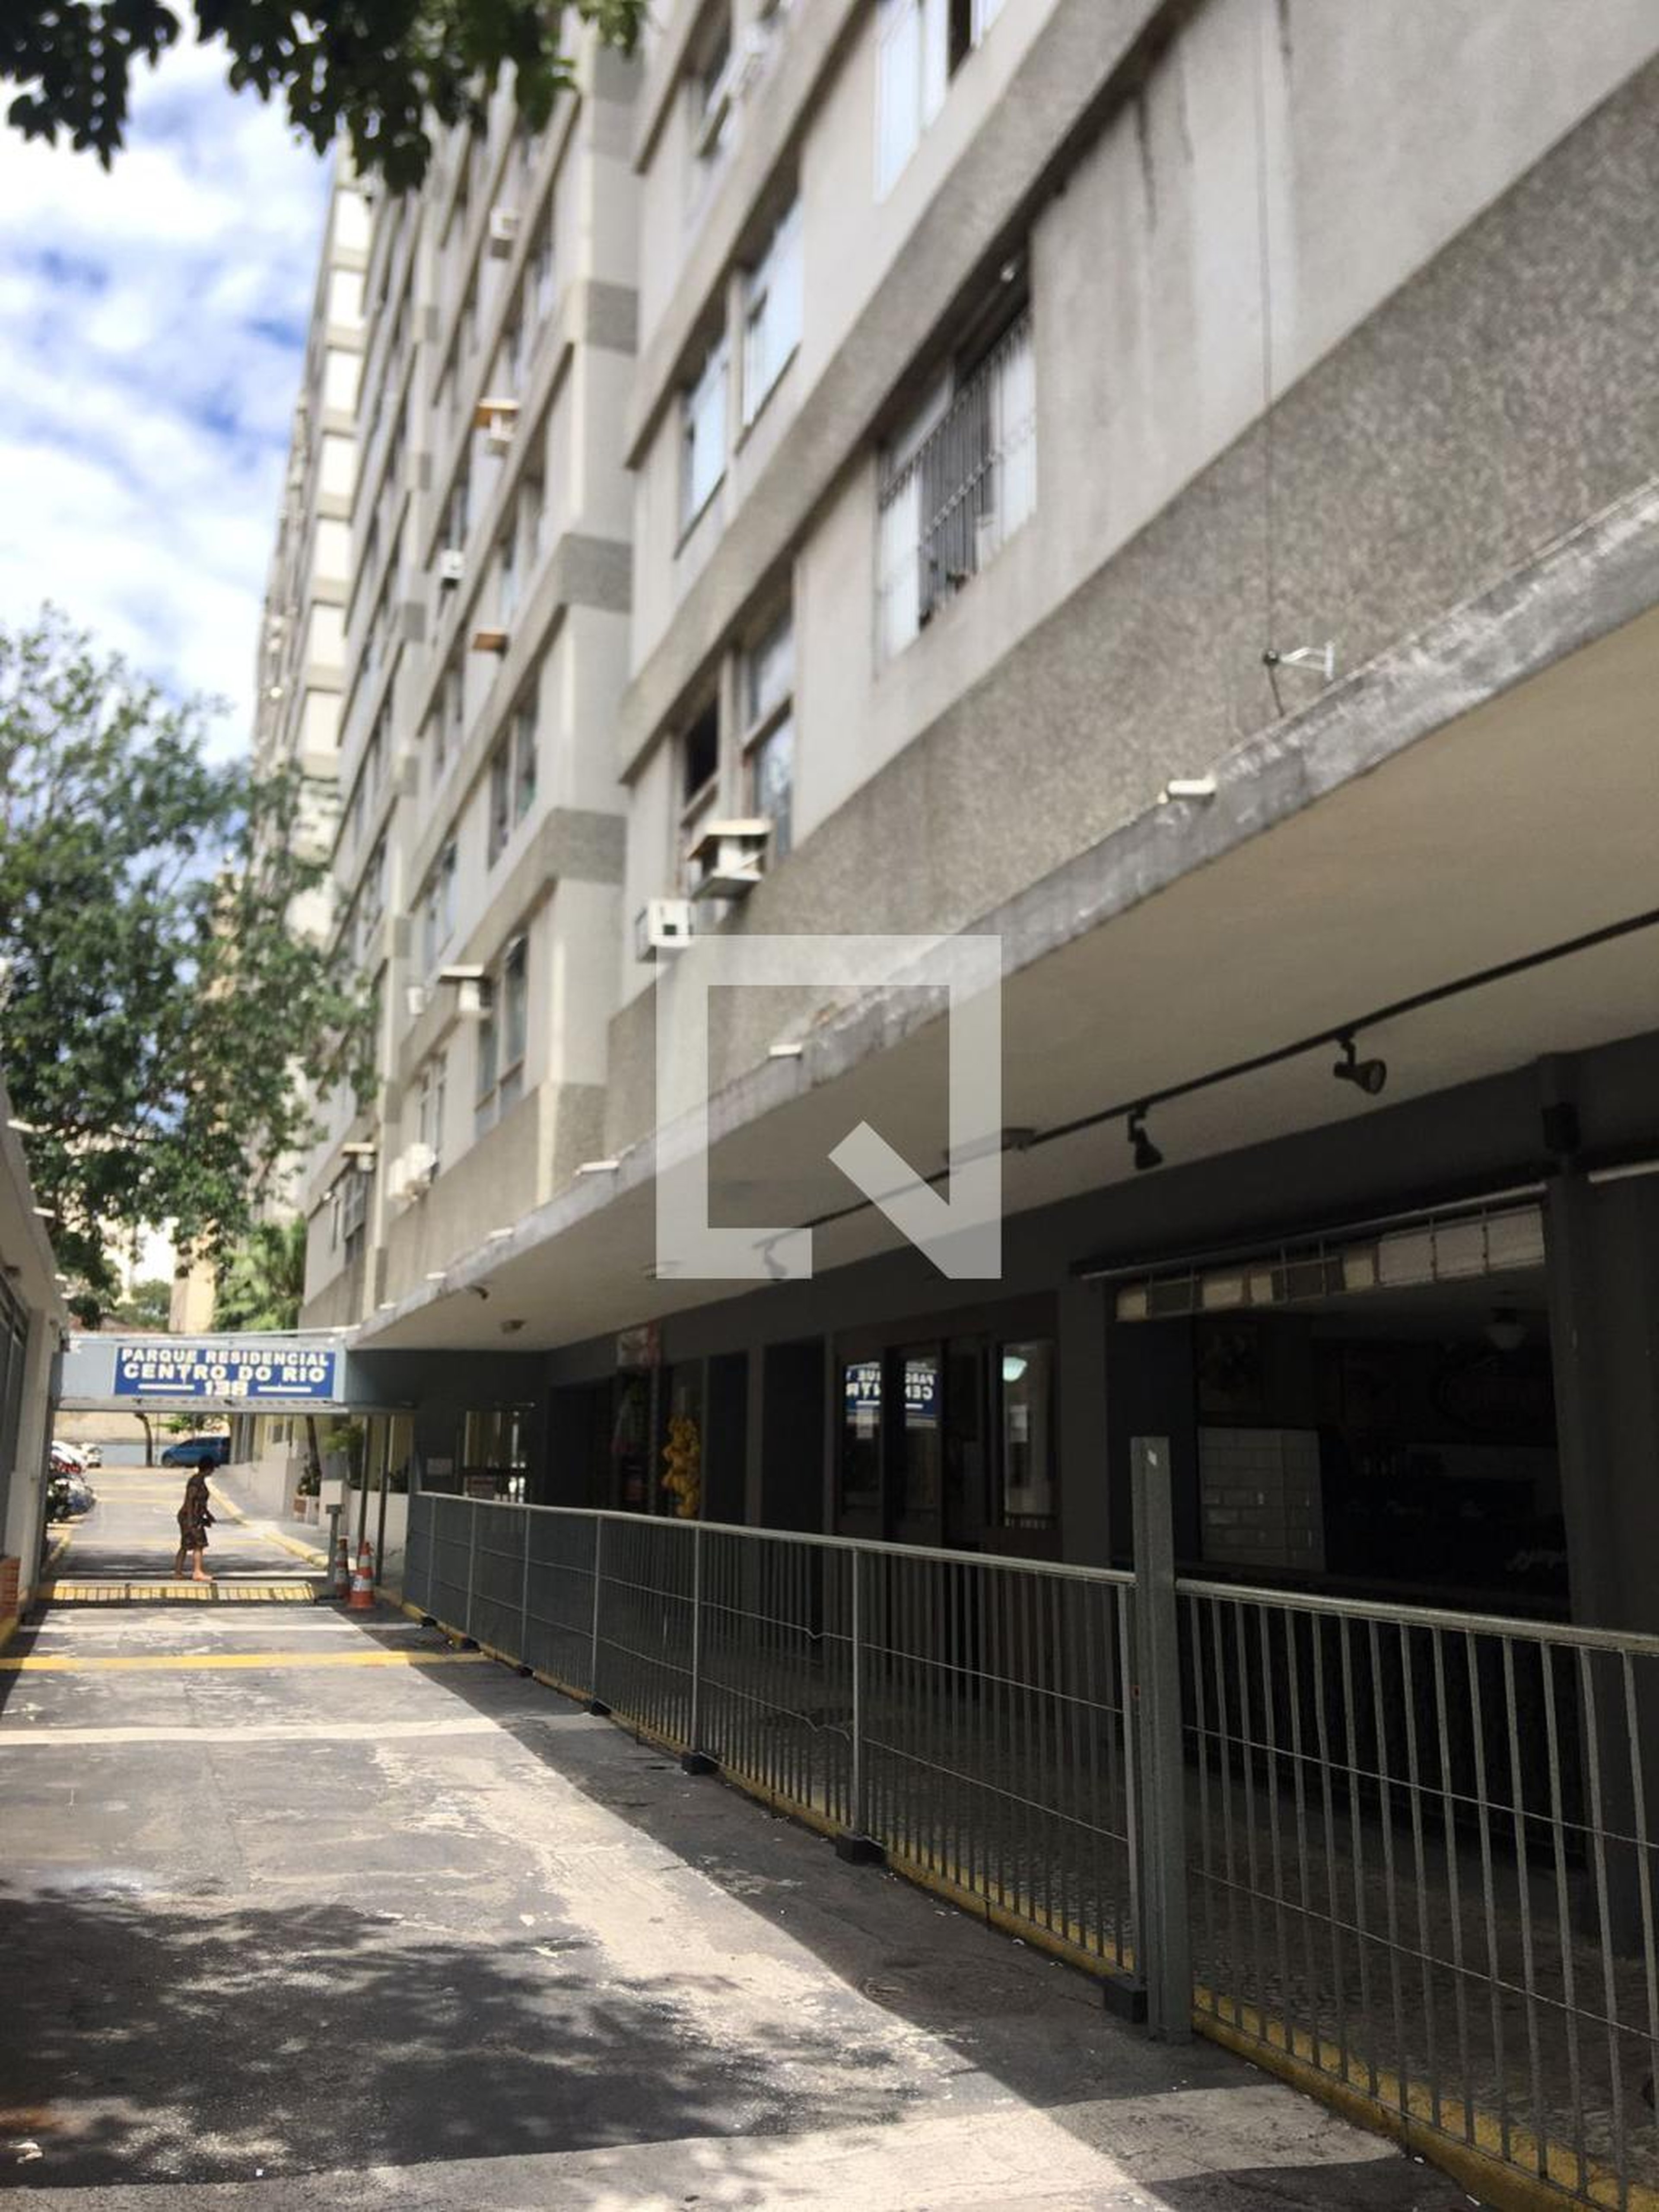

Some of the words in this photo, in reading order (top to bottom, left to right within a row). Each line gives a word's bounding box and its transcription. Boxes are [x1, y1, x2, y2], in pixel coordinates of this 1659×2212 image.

[122, 1348, 197, 1362] PARQUE
[205, 1349, 329, 1366] RESIDENCIAL
[123, 1362, 226, 1381] CENTRO
[238, 1365, 271, 1381] DO
[282, 1367, 325, 1383] RIO
